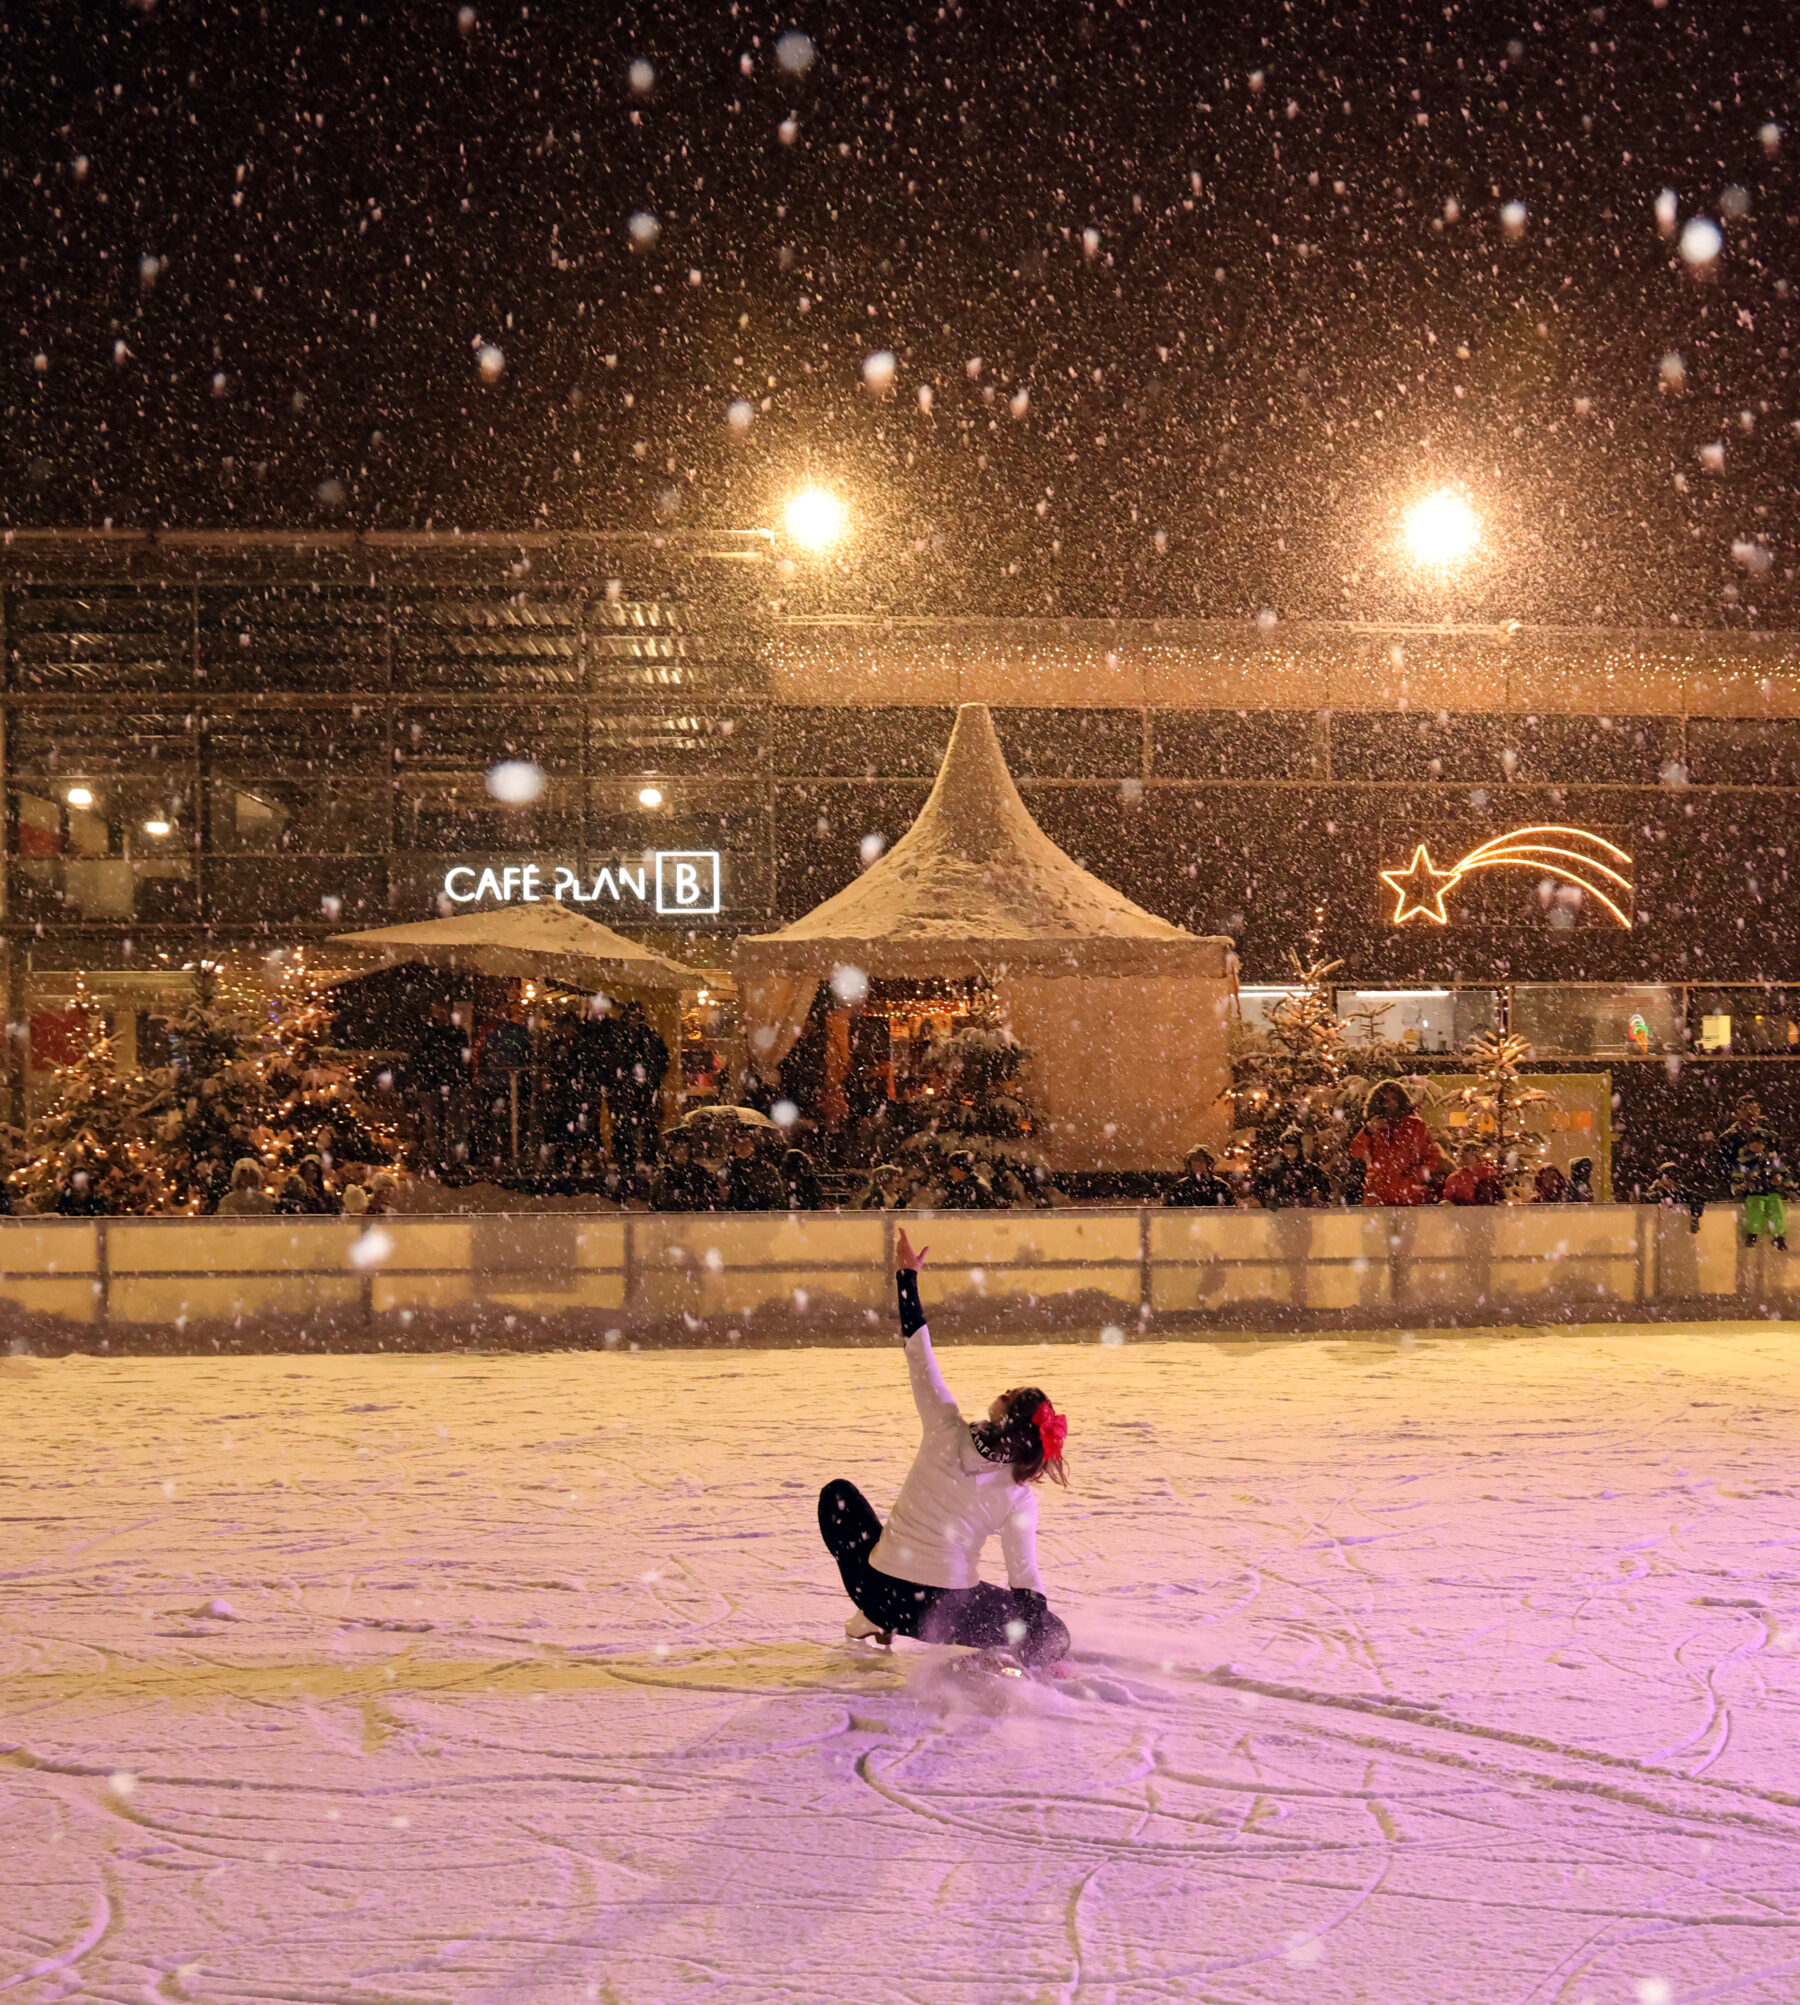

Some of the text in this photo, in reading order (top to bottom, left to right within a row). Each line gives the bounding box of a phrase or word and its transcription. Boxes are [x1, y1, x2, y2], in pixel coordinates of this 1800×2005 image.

[444, 863, 701, 905] CAFÉ PLAN B
